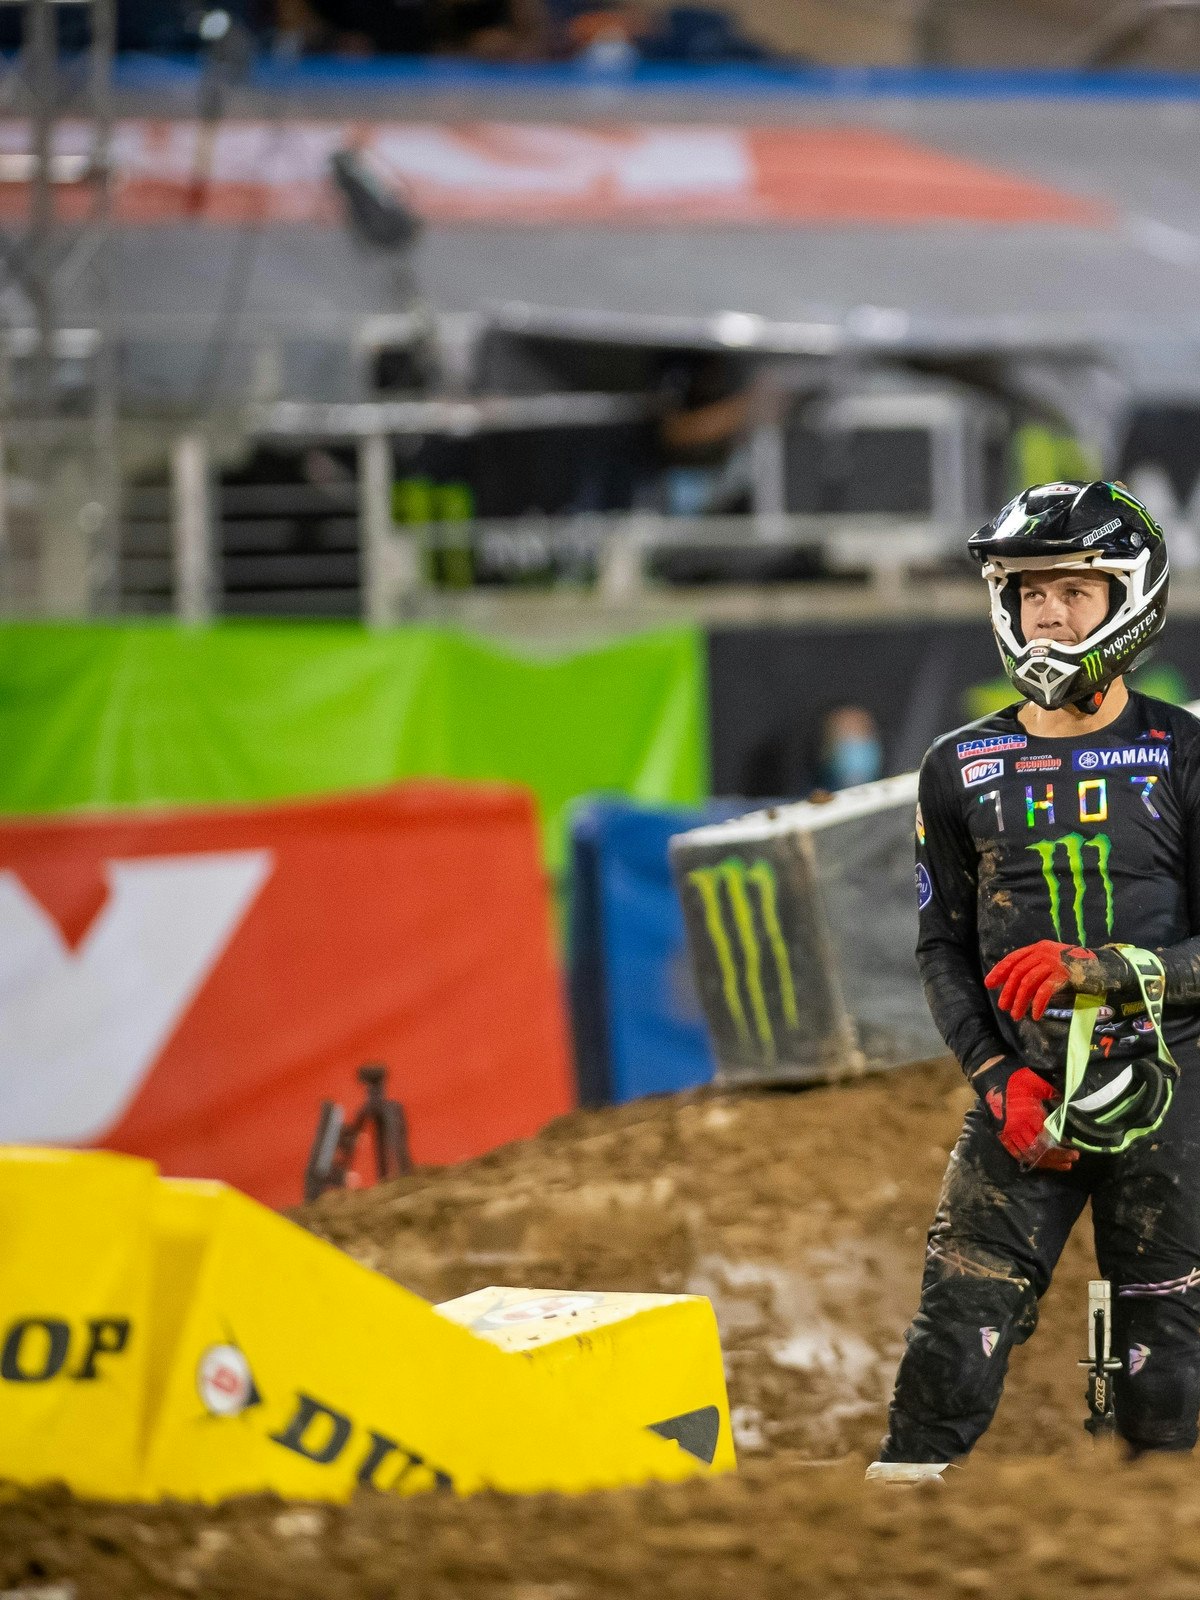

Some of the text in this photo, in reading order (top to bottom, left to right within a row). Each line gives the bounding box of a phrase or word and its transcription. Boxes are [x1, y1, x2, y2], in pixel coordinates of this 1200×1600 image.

[1103, 609, 1158, 658] MONSTER
[957, 734, 1027, 753] PARTS
[1100, 748, 1169, 767] YAMAHA
[966, 762, 998, 783] 100%
